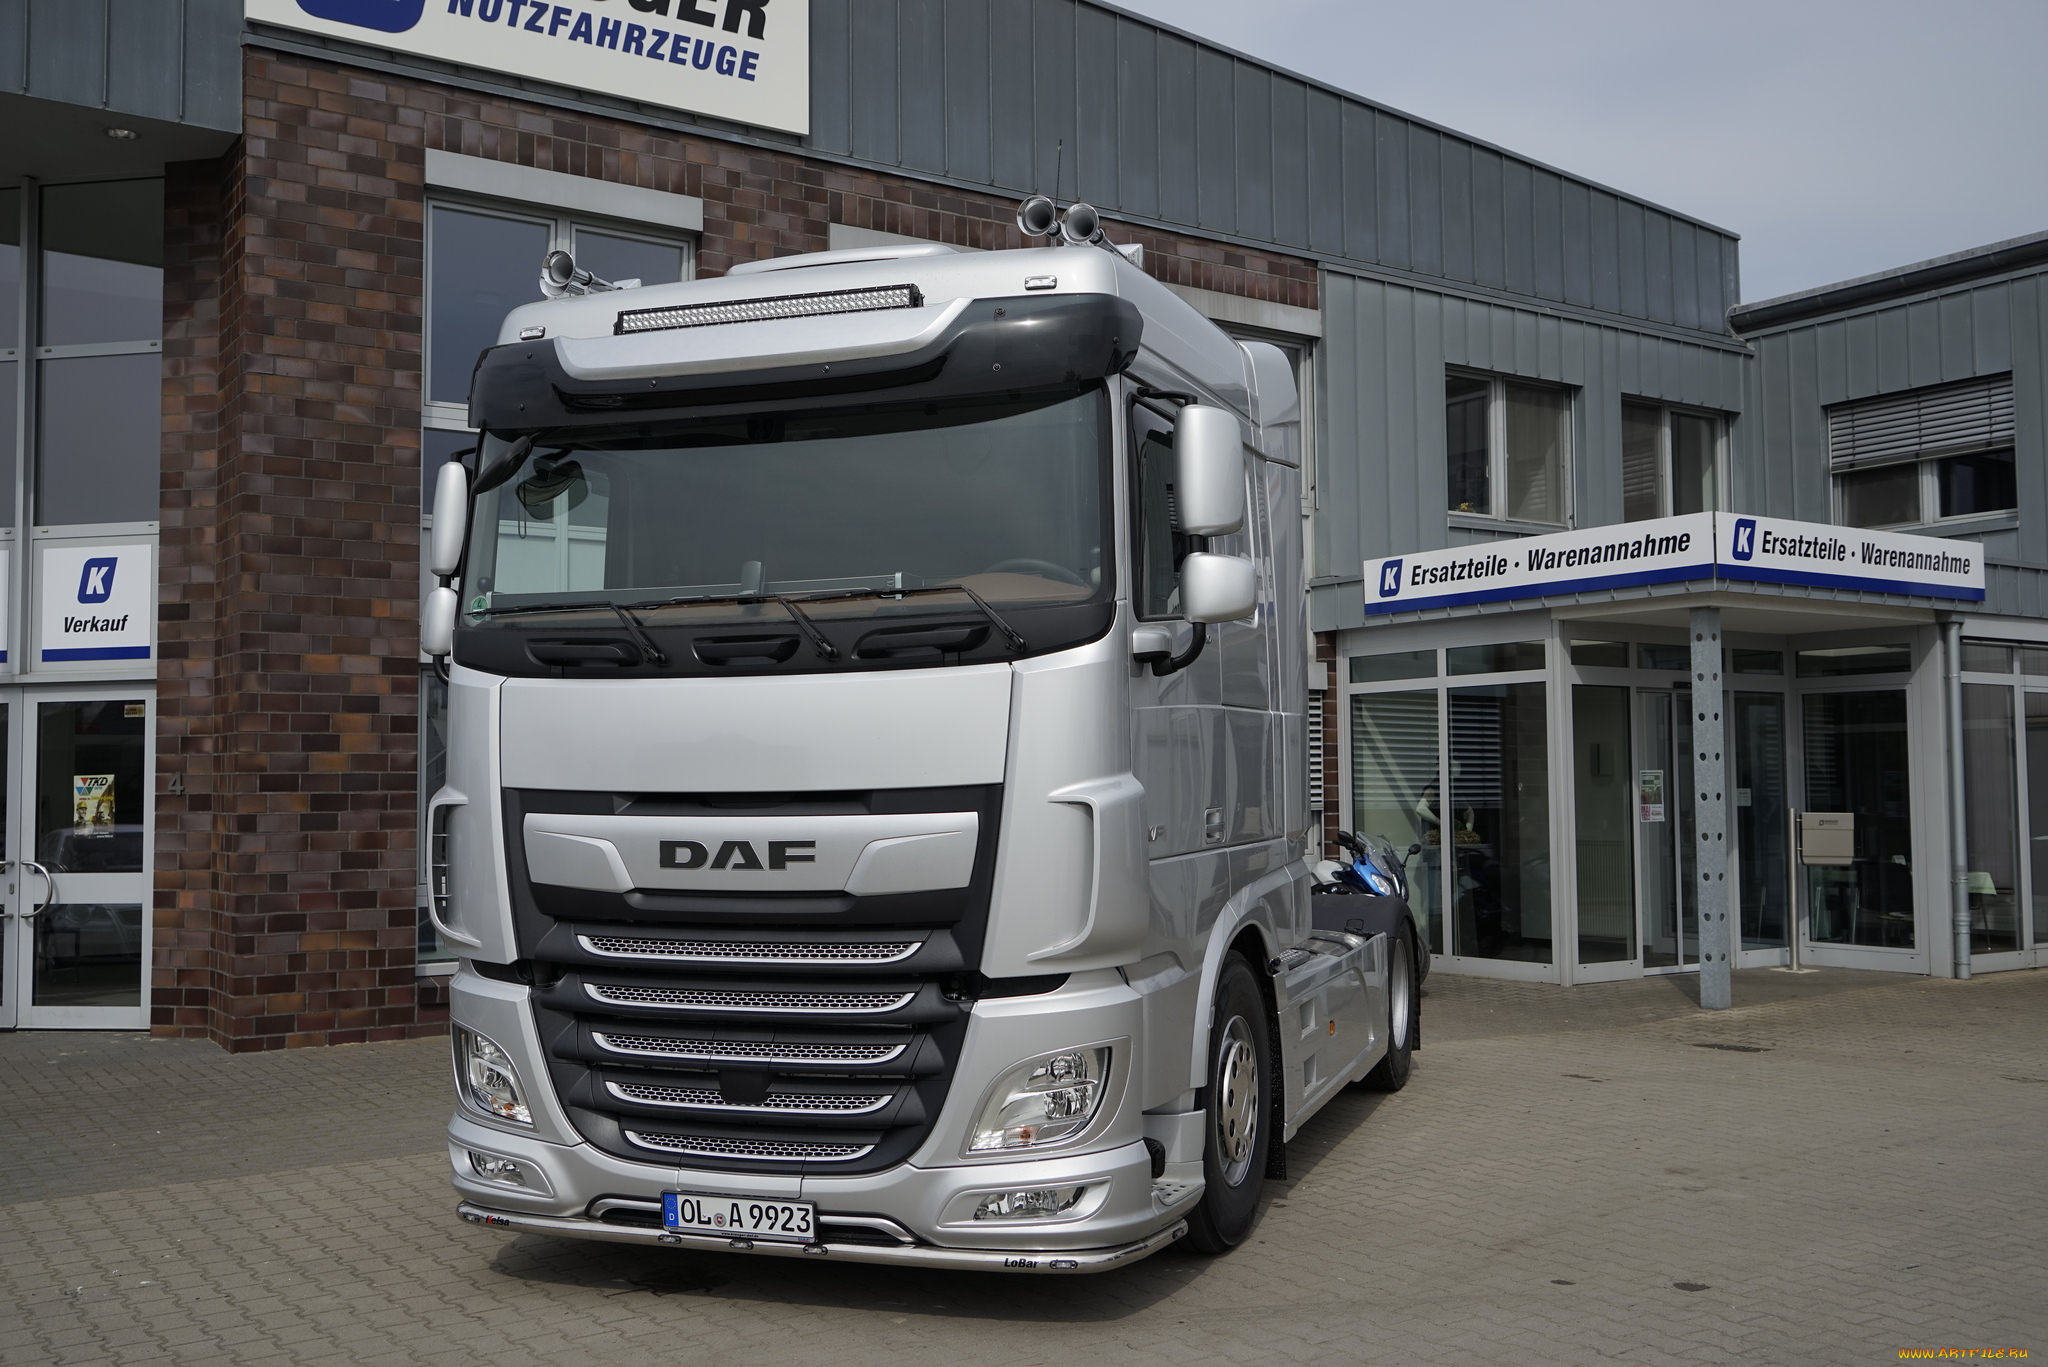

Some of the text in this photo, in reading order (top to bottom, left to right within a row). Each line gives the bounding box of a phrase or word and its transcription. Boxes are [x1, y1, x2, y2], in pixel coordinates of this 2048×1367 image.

[447, 0, 759, 81] NUTZFAHRZEUGE
[1383, 532, 1691, 591] K Ersatzteile Warenannahme
[1738, 527, 1970, 575] K Ersatzteile Warenannahme
[86, 566, 109, 595] K
[64, 614, 129, 633] Verkauf
[88, 777, 109, 787] TKD
[168, 772, 184, 795] 4
[660, 840, 816, 871] DAF
[669, 1213, 675, 1221] D
[681, 1198, 811, 1233] OL A 9923
[1004, 1257, 1039, 1269] LoBar
